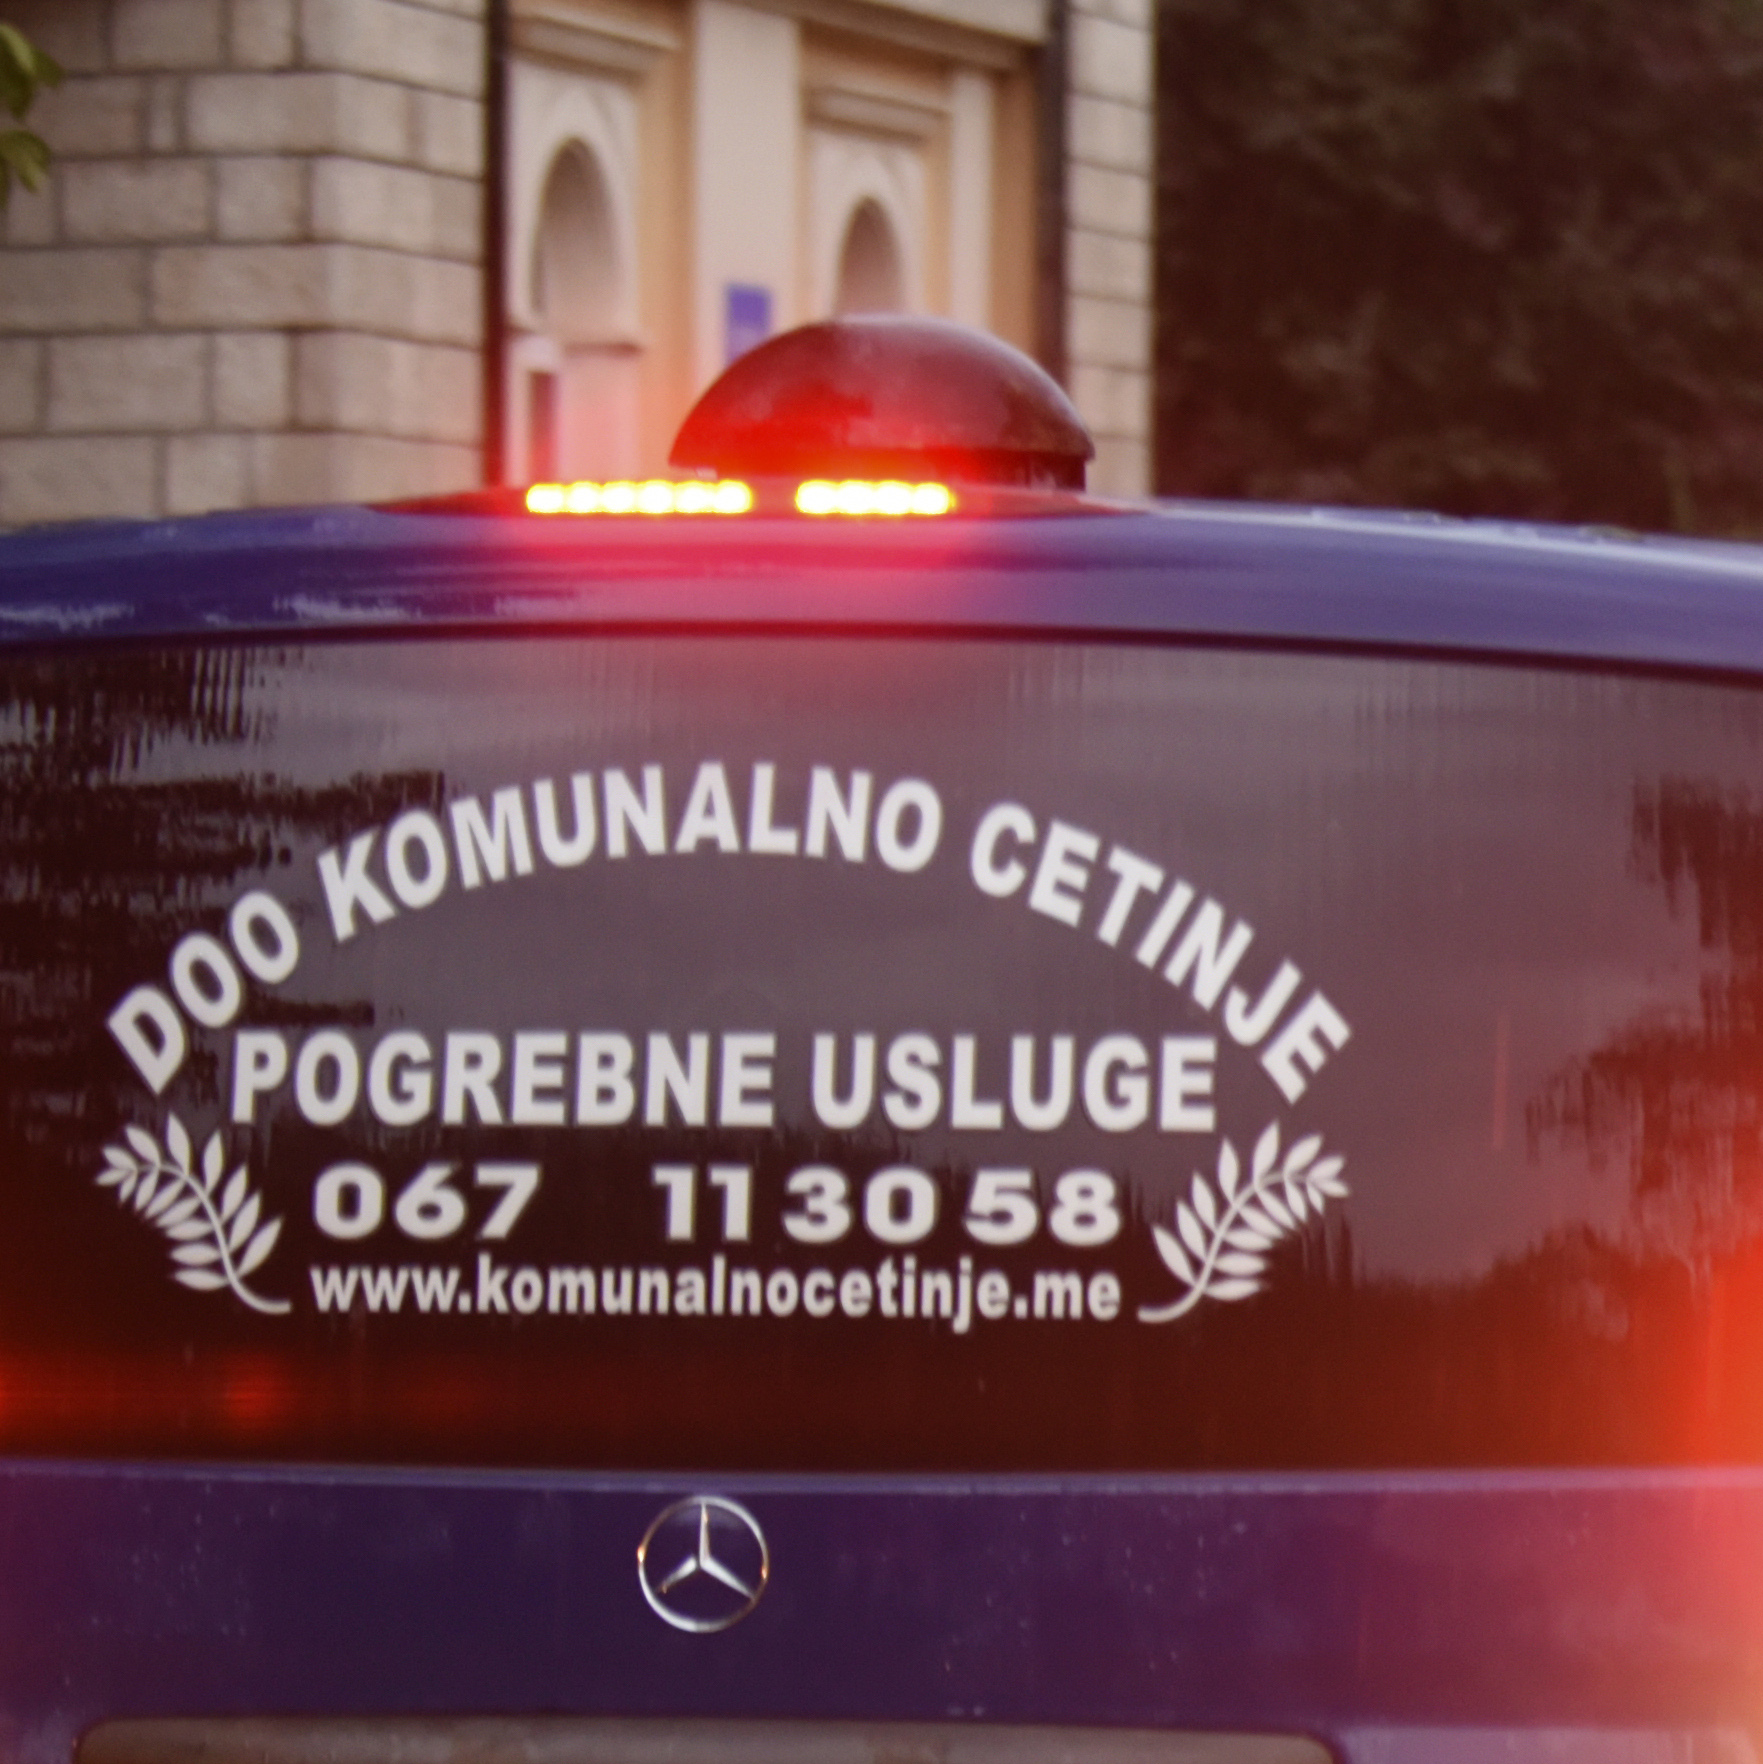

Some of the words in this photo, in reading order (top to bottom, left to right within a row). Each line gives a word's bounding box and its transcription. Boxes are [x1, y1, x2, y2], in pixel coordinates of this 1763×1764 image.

[107, 890, 300, 1093] DOO
[317, 760, 944, 942] KOMUNALNO
[969, 801, 1351, 1105] CETINJE
[232, 1030, 777, 1126] POGREBNE
[811, 1032, 1218, 1132] USLUGE
[314, 1165, 539, 1238] 067
[310, 1254, 1121, 1333] www.komunalnocetinje.me
